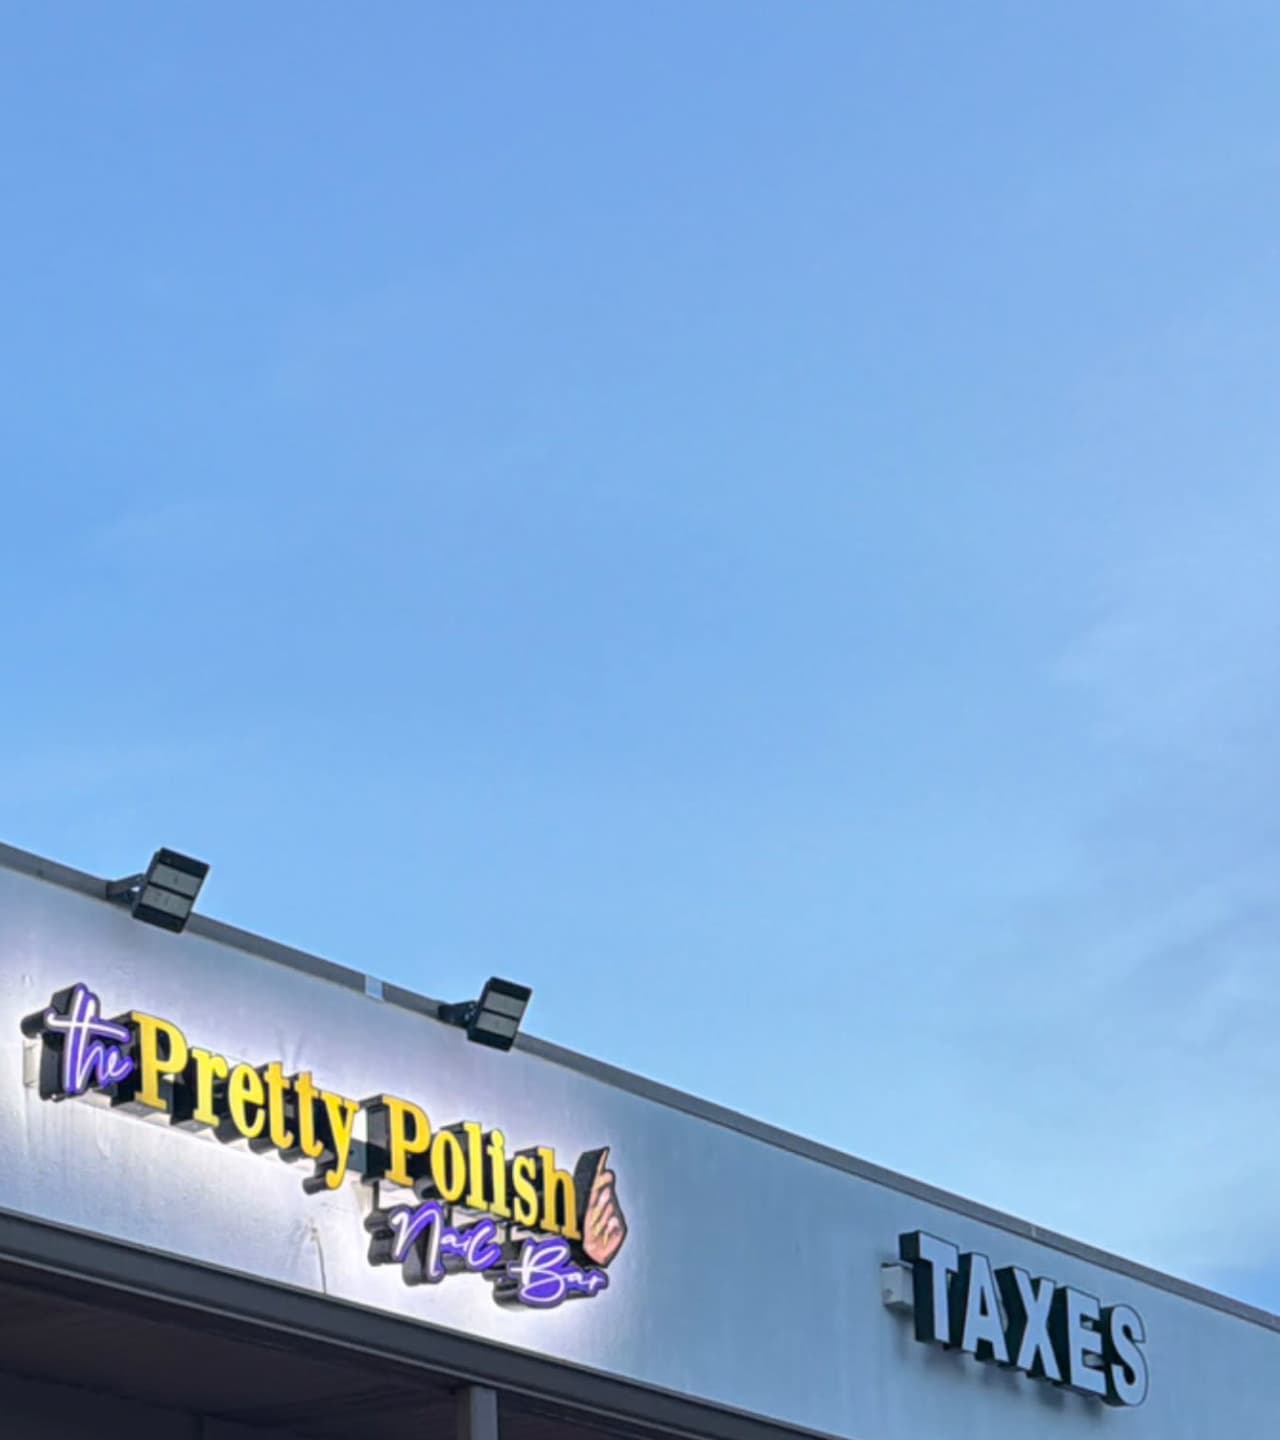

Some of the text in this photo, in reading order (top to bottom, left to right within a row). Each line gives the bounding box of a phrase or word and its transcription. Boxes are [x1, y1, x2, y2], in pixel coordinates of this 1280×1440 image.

[34, 982, 135, 1097] the
[126, 1010, 583, 1242] Pretty Polish
[383, 1200, 610, 1306] Nail Bar
[910, 1230, 1149, 1407] TAXES
